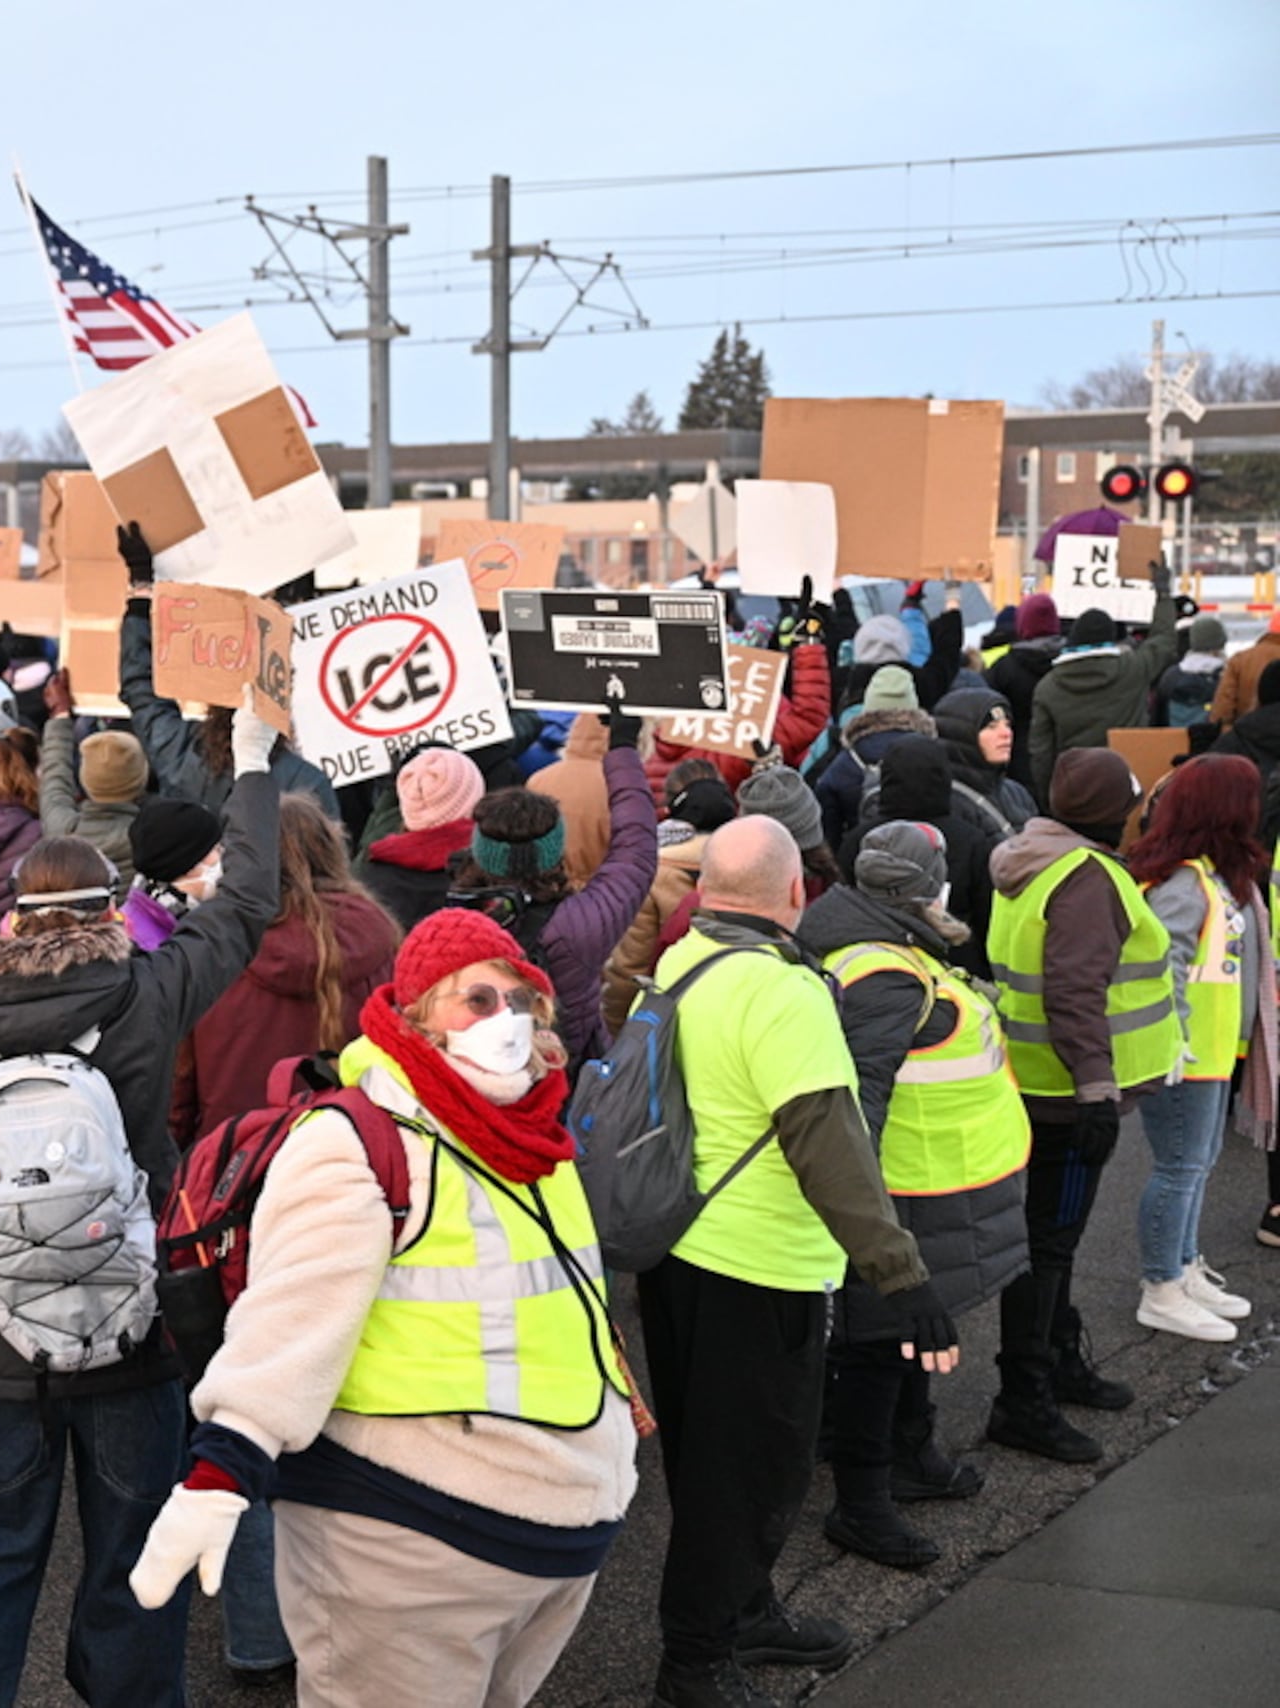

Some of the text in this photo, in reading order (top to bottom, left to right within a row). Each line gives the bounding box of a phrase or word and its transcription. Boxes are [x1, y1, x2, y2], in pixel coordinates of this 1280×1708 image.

[1091, 544, 1109, 563] N
[330, 580, 438, 631] DEMAND
[334, 641, 441, 721] ICE
[671, 716, 759, 749] MSP
[321, 744, 375, 781] DUE
